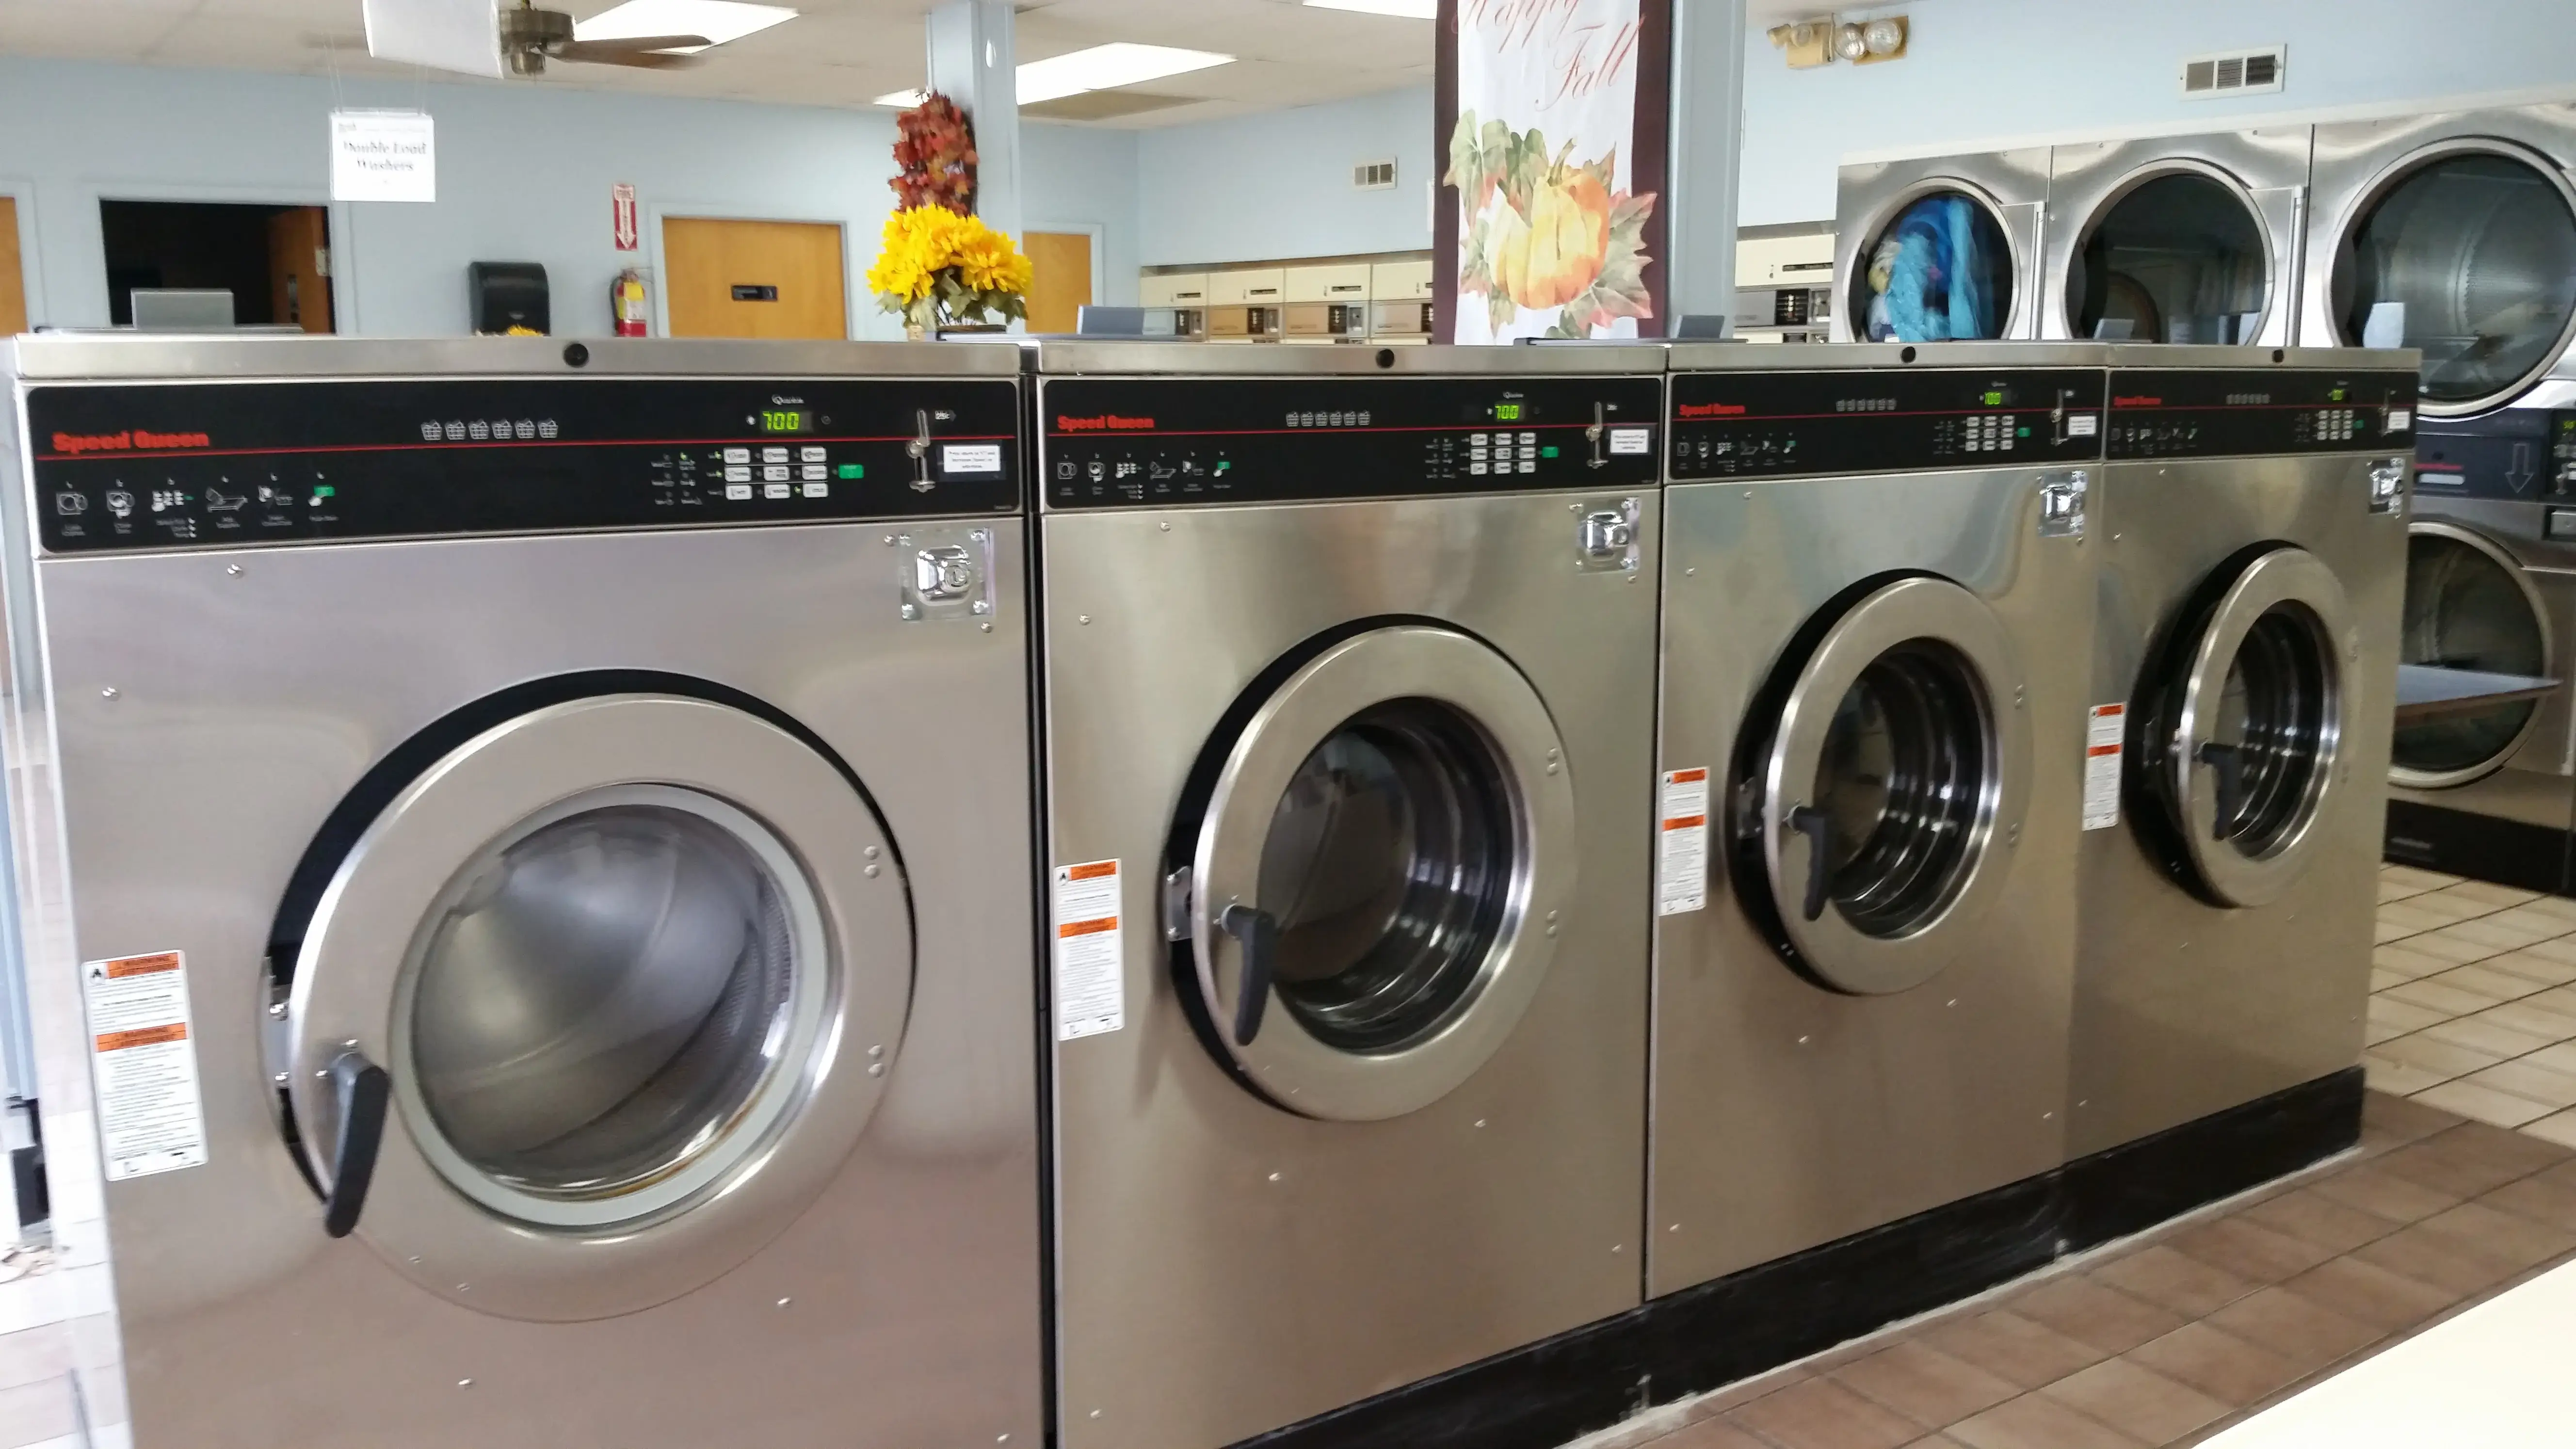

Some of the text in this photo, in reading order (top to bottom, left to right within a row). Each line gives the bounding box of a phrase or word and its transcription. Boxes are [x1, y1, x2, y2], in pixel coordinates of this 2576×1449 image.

[1534, 13, 1647, 112] Fall
[343, 140, 427, 154] Double Load
[357, 157, 414, 172] Washers
[1495, 405, 1519, 419] 700
[762, 411, 799, 431] 700
[1057, 415, 1154, 432] Speed Queen
[52, 429, 209, 454] Speed Queen
